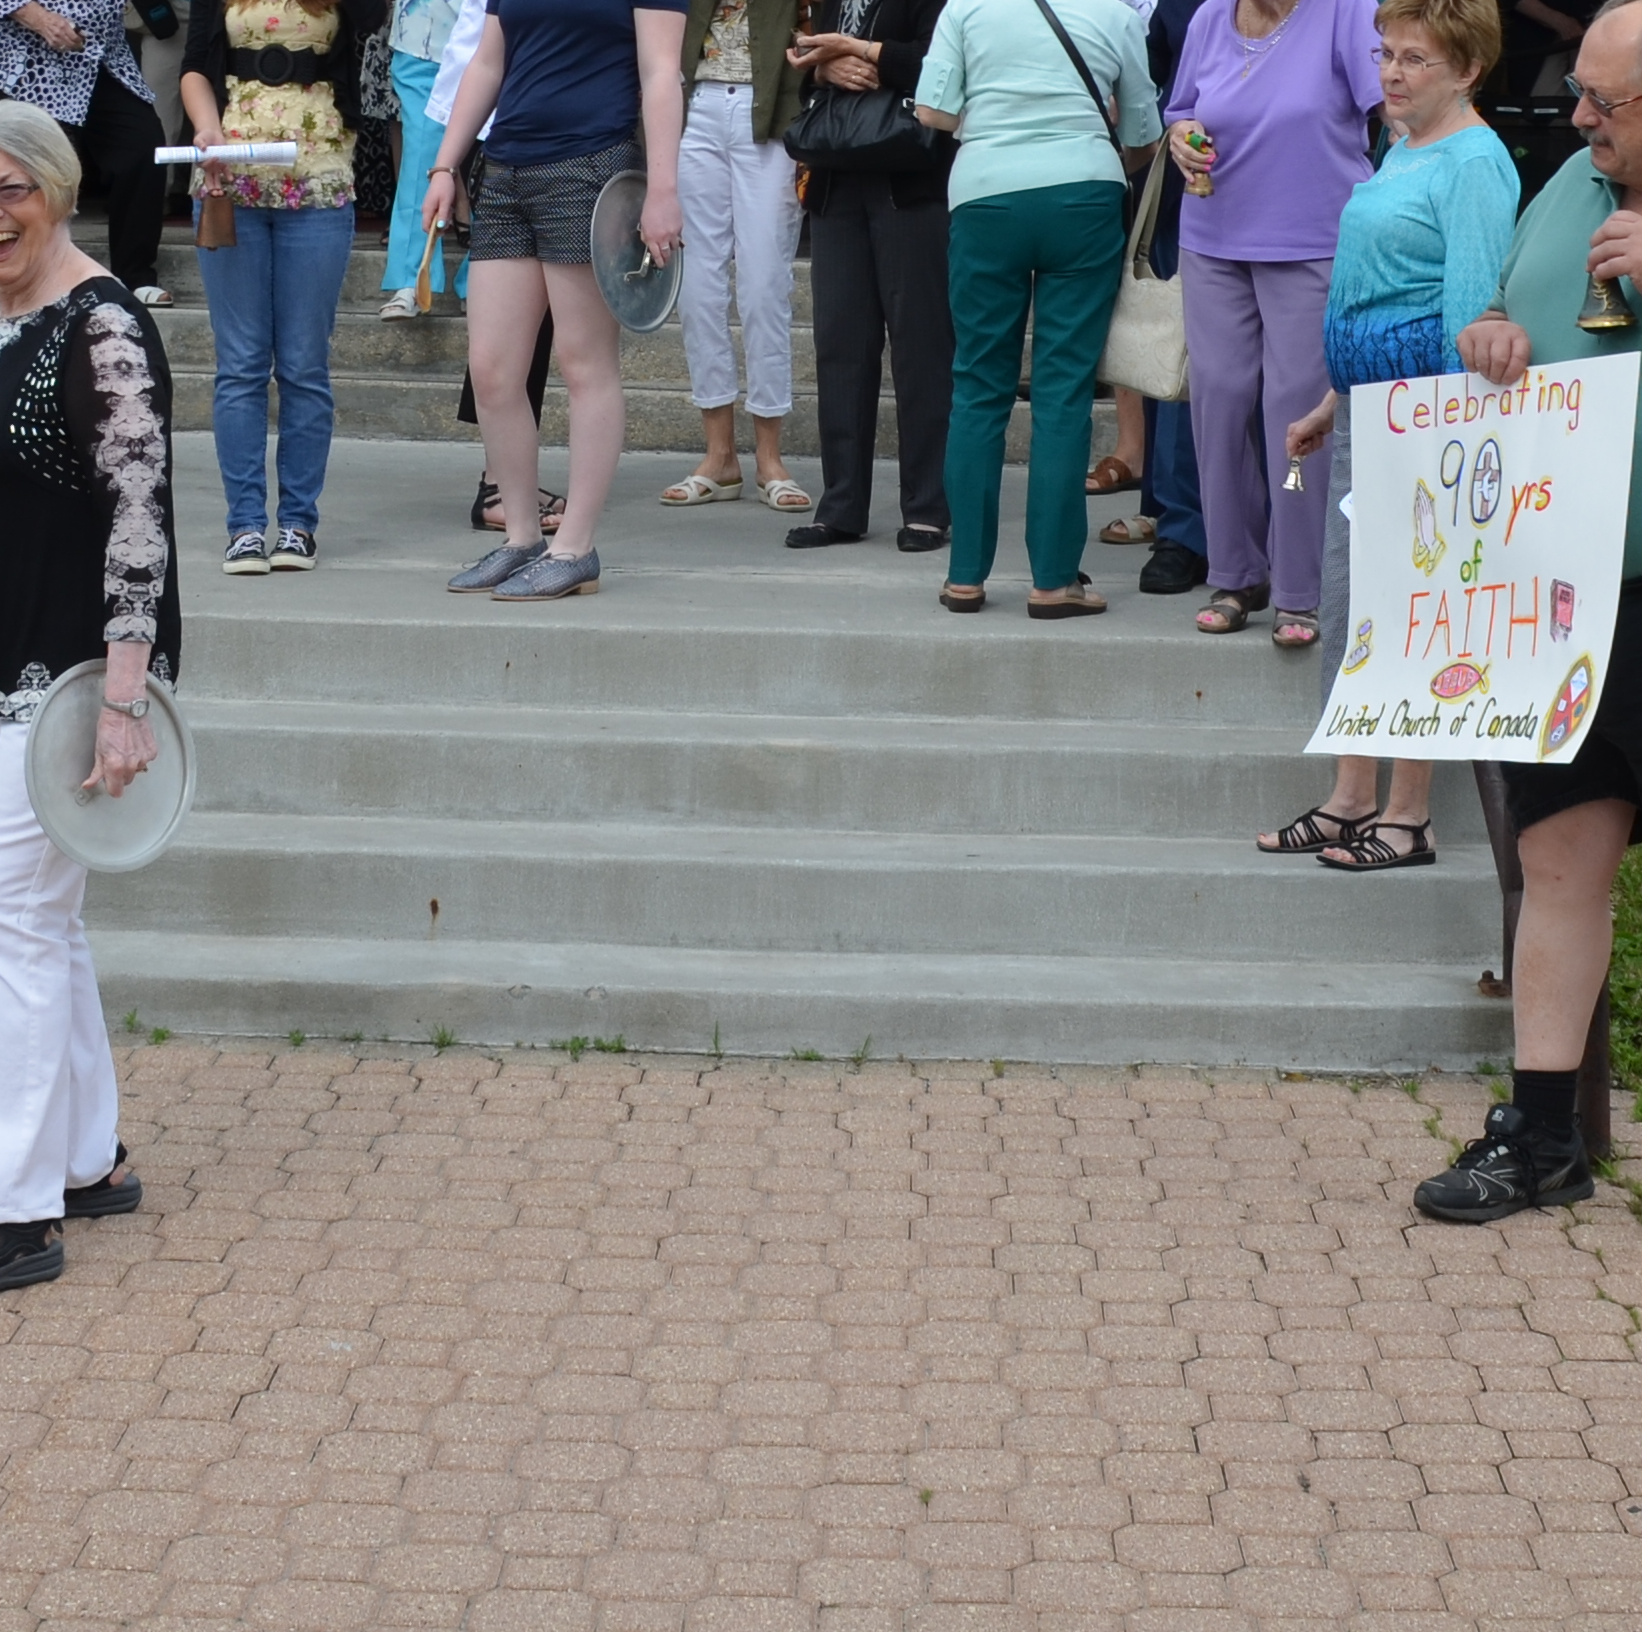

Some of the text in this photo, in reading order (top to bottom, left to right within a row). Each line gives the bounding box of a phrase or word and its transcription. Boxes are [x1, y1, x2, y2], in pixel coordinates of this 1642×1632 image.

[1387, 369, 1581, 434] Celebrating
[1440, 438, 1552, 546] 90 yrs
[1460, 539, 1483, 583] of
[1404, 576, 1538, 660] FAITH
[1326, 697, 1538, 740] United Church of Canada
